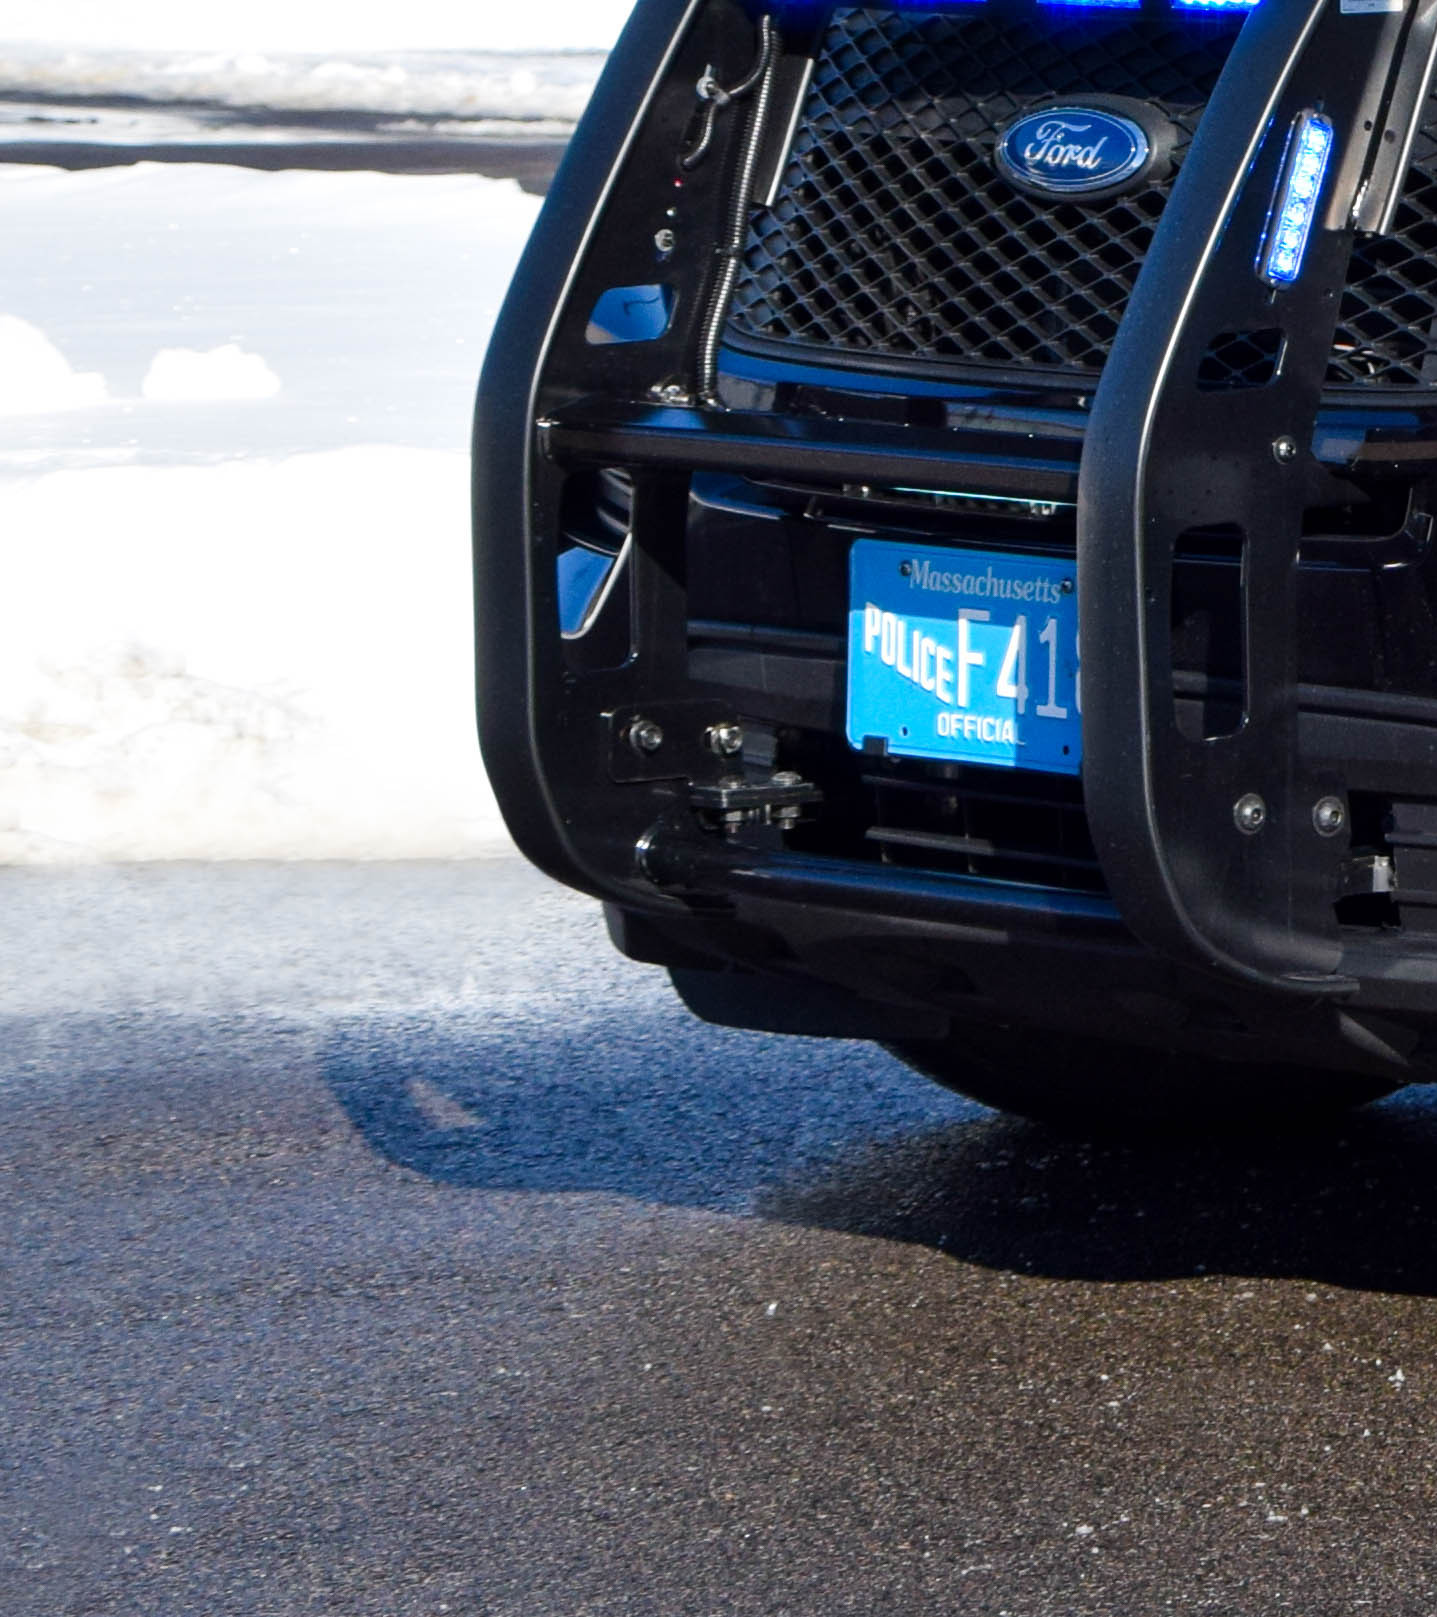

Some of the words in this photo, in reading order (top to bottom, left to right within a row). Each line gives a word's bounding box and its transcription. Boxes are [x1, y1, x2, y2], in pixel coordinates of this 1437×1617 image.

[1023, 119, 1107, 170] Ford
[909, 558, 1063, 604] Massachusetts
[864, 601, 955, 706] POLICE
[957, 606, 1081, 720] F41
